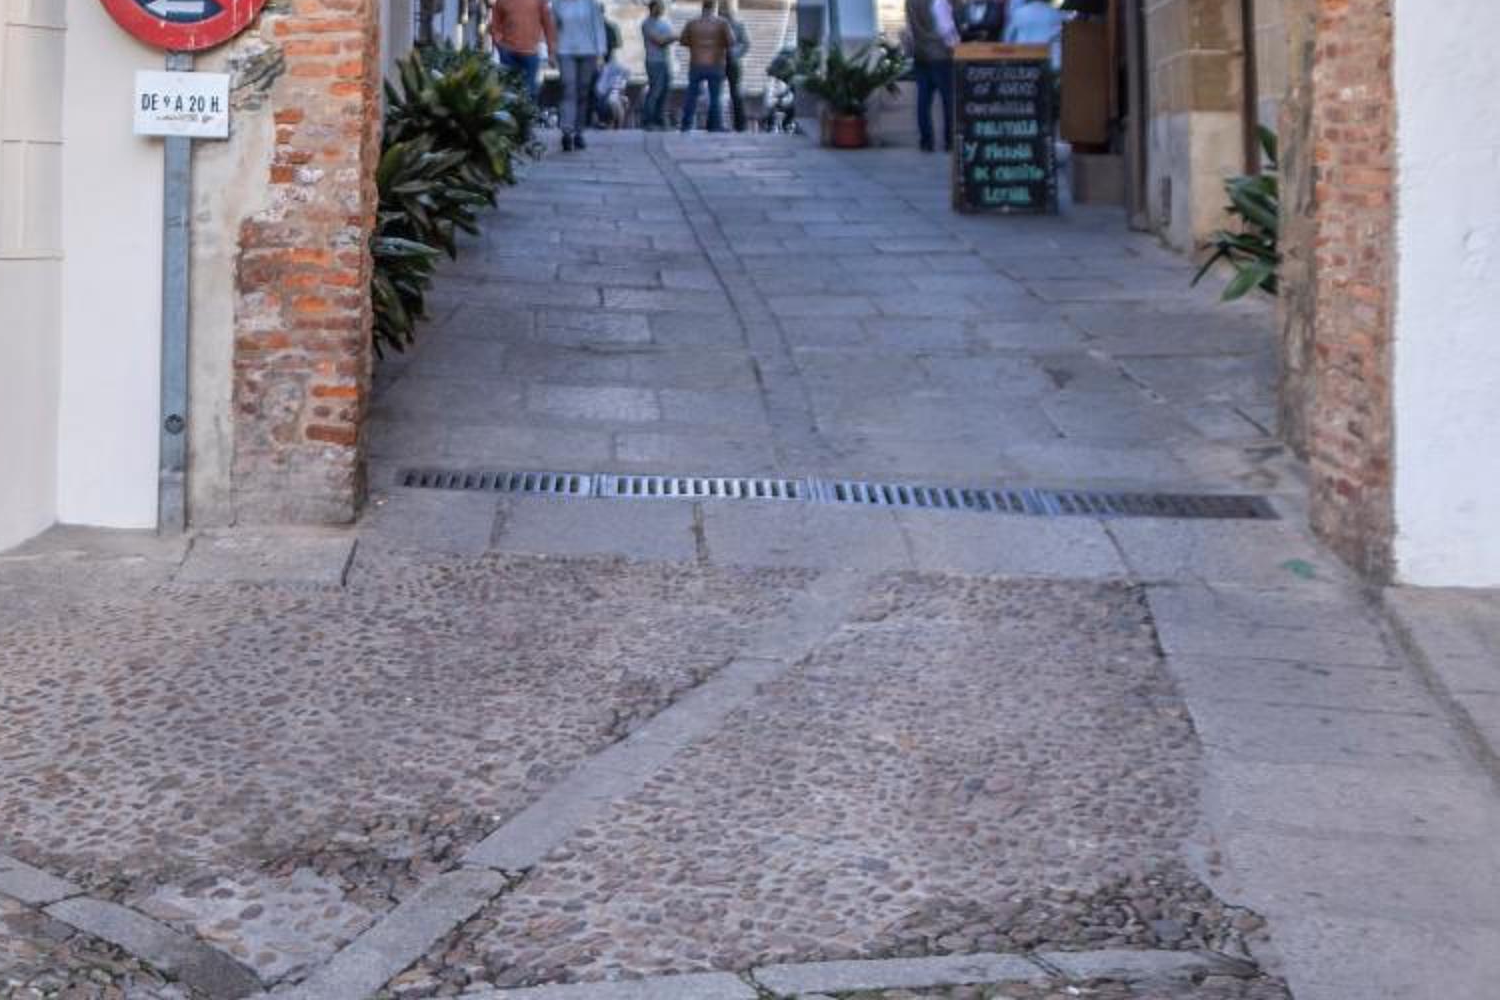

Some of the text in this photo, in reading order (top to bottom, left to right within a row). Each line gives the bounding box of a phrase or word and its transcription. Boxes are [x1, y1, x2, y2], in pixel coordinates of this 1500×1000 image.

[141, 93, 159, 111] DE
[175, 95, 183, 112] A
[189, 95, 206, 113] 20
